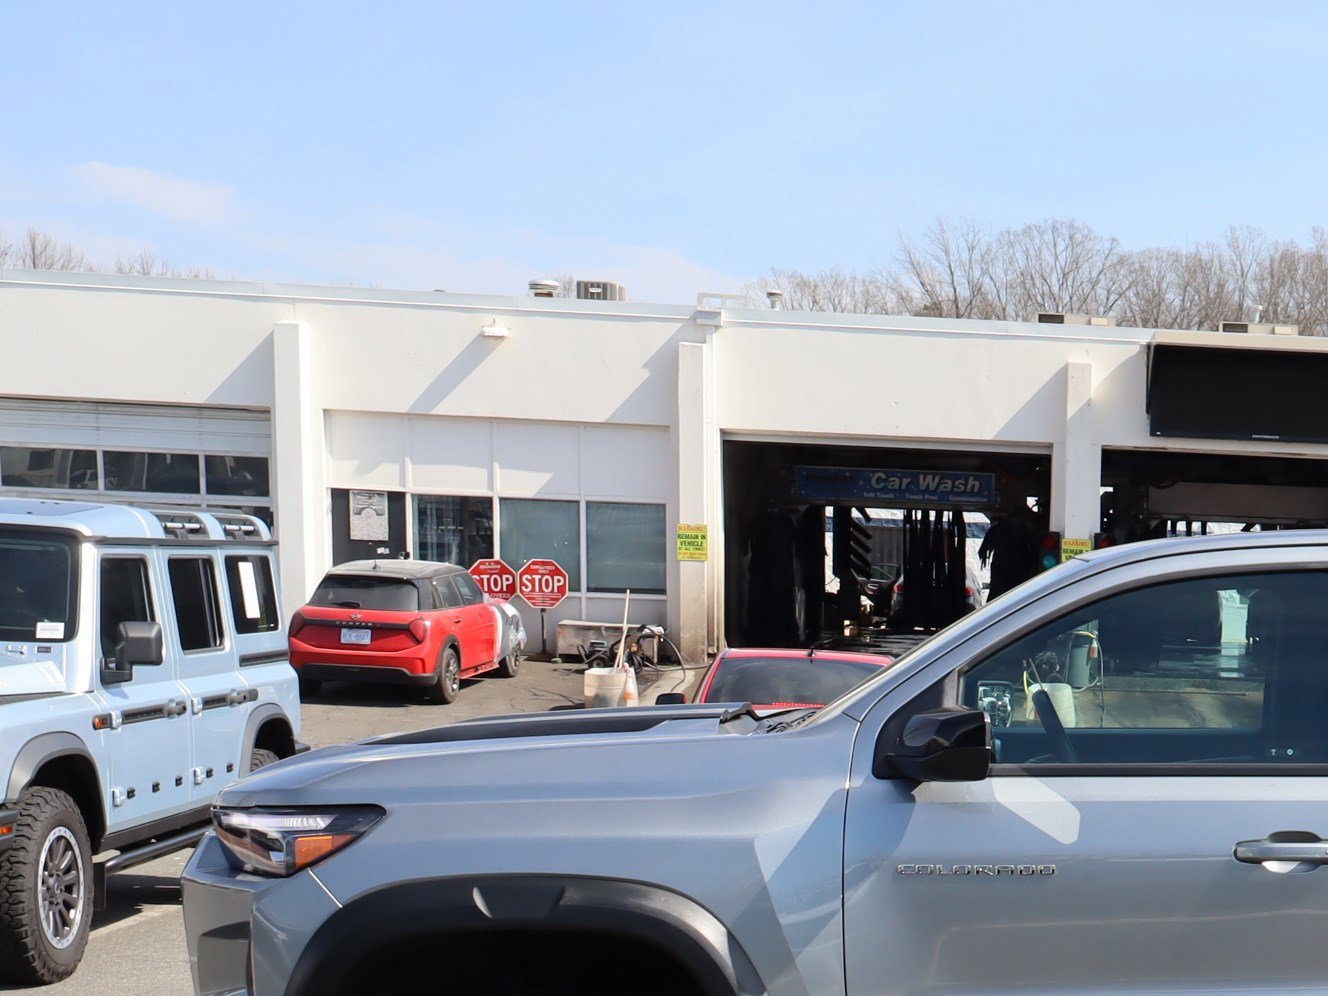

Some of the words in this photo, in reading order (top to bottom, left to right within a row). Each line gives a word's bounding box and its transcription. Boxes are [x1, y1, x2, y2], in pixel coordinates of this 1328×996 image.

[870, 472, 912, 490] Car
[918, 474, 982, 493] Wash
[876, 491, 895, 499] Touch
[521, 574, 565, 593] STOP
[897, 863, 1057, 876] COLORADO
